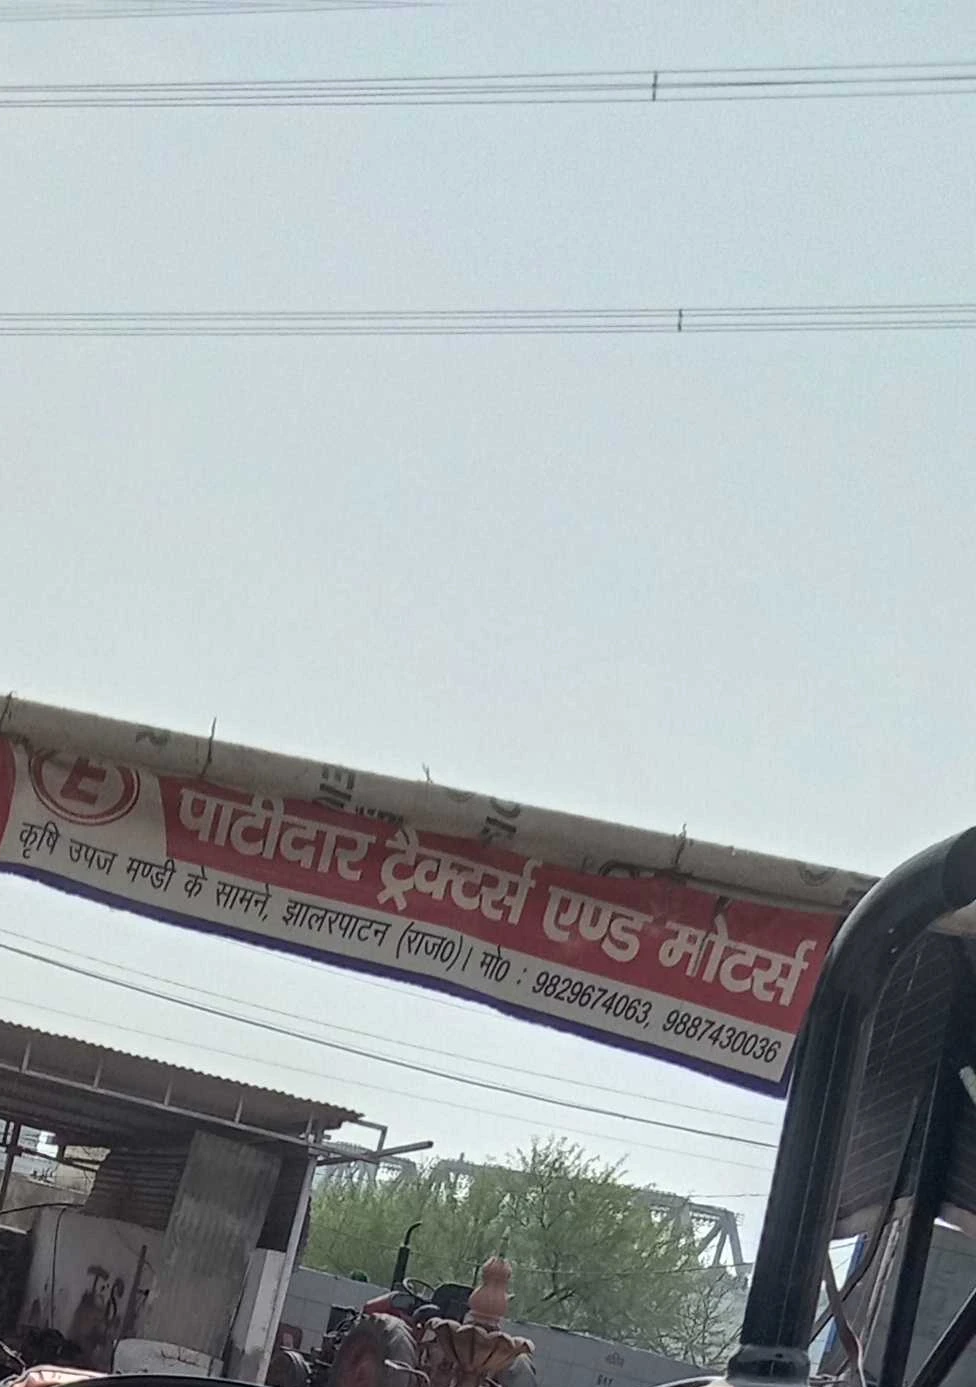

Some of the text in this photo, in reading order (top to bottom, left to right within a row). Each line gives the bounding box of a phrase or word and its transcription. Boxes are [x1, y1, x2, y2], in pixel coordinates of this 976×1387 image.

[19, 821, 60, 860] कृषि
[68, 838, 117, 874] उपज
[126, 857, 175, 892] मण्डी
[184, 866, 207, 896] के
[215, 880, 272, 921] सामने,
[282, 900, 390, 946] झालरपाटन
[531, 972, 651, 1029] 9829674063,
[662, 1010, 781, 1063] 9887430036
[178, 789, 377, 880] पाटीदार
[379, 829, 543, 927] ट्रैक्टर्स
[544, 886, 651, 963] एण्ड
[658, 916, 817, 1008] मोटर्स
